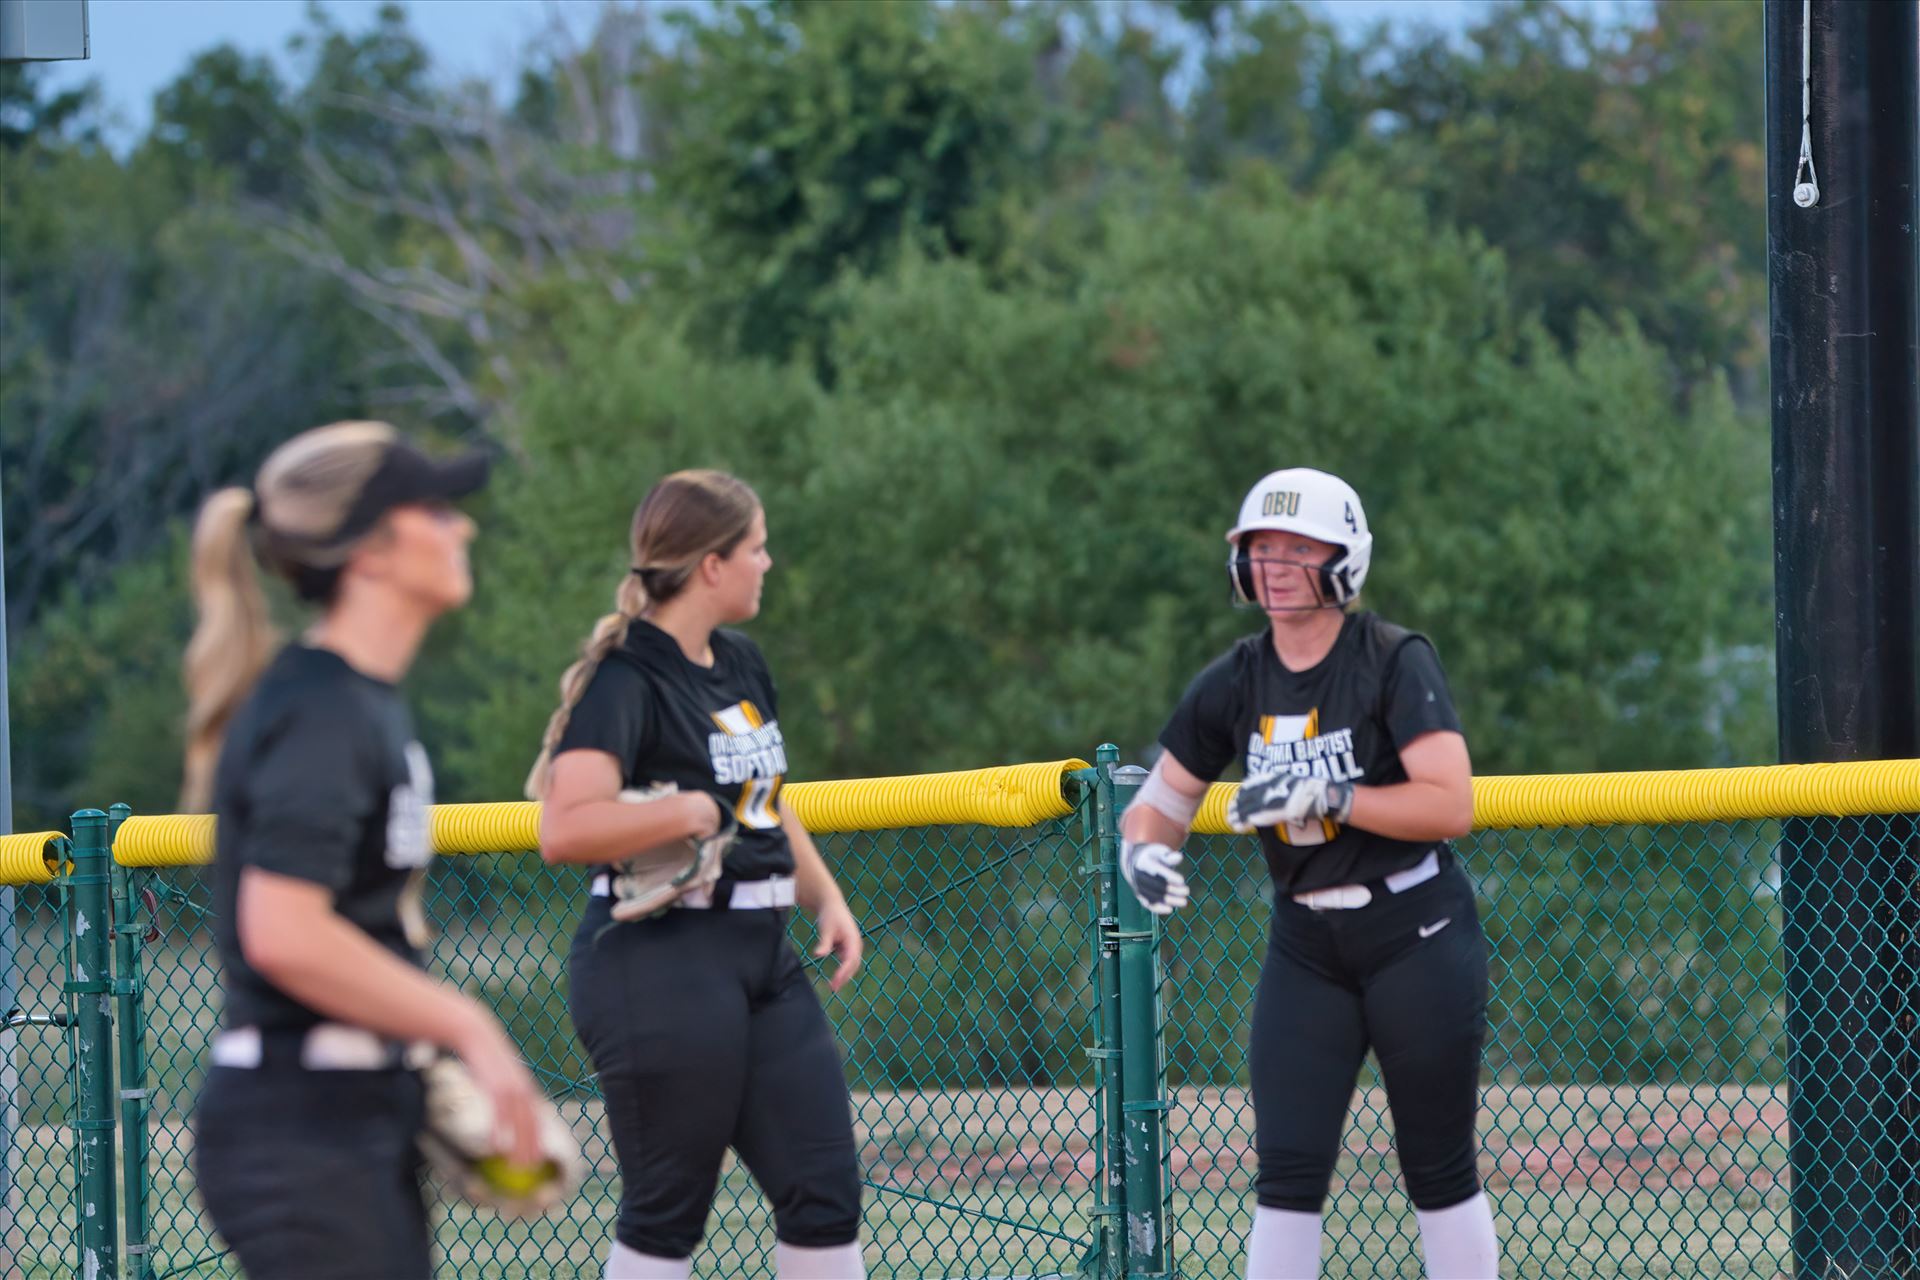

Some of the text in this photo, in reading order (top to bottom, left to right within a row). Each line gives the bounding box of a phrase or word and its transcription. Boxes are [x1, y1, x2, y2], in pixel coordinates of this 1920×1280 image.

[1262, 491, 1301, 517] OBU
[1344, 501, 1358, 534] 4
[1293, 728, 1354, 761] BAPTIST
